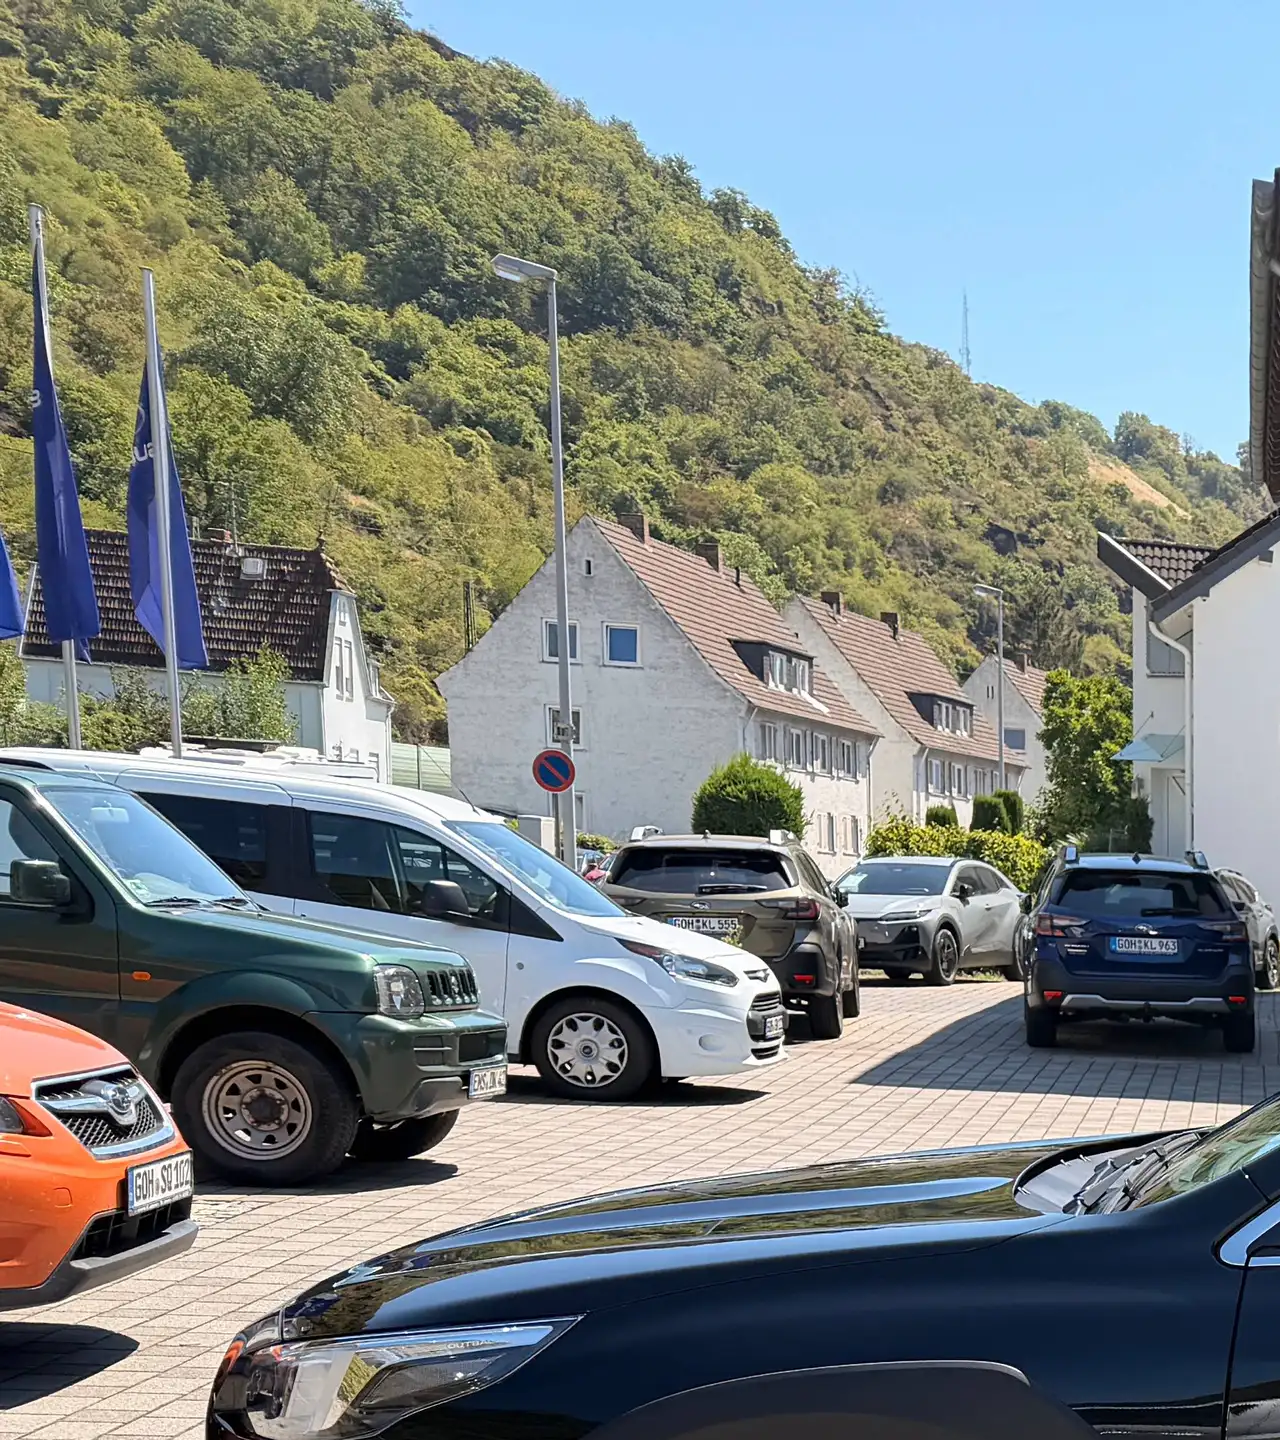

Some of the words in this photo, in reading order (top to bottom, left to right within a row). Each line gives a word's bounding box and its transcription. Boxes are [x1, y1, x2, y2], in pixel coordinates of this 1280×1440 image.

[673, 918, 694, 931] GOH
[702, 919, 716, 931] KL
[717, 919, 738, 931] 555
[1117, 938, 1138, 951] GOH
[1143, 939, 1157, 952] KL
[1159, 940, 1177, 952] 963
[134, 1168, 155, 1203] GOH
[173, 1157, 190, 1190] 102
